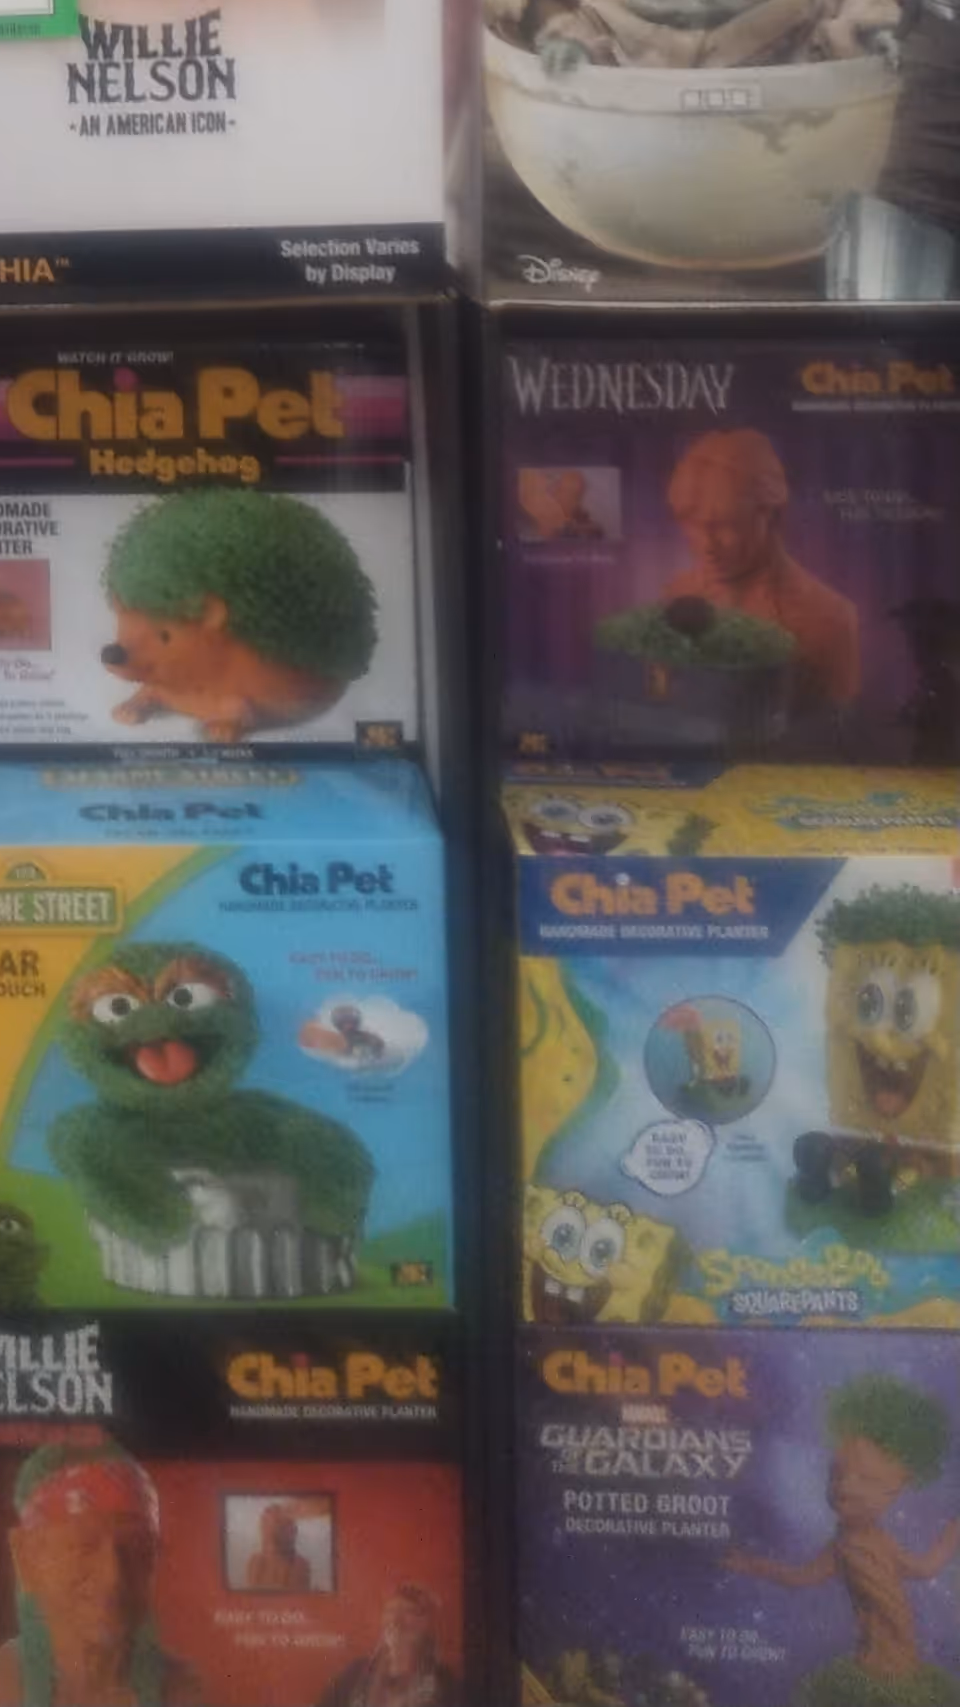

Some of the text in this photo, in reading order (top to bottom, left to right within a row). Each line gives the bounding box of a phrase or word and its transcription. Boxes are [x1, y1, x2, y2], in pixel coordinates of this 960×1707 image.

[77, 5, 222, 61] WILLIE
[66, 58, 238, 104] NELSON
[79, 114, 101, 137] AN
[106, 112, 188, 136] AMERICAN
[280, 238, 421, 259] Selection Varies
[305, 263, 397, 286] by Display
[517, 254, 603, 291] Disney
[508, 355, 736, 416] WEDNESDAY
[800, 360, 955, 396] Chia Pet
[7, 365, 345, 442] Chia Pet
[89, 447, 262, 483] Hedgehog
[79, 802, 265, 822] Chia Pet
[239, 862, 394, 896] Chia Pet
[550, 872, 755, 916] Chia Pet
[31, 891, 113, 922] STREET
[732, 1289, 859, 1315] SQUAREPANTS
[226, 1351, 438, 1400] Chia Pet
[542, 1349, 749, 1399] Chia Pet
[540, 1424, 753, 1455] GUARDIANS
[584, 1450, 748, 1479] GALAXY
[563, 1490, 730, 1517] POTTED GROOT
[565, 1517, 730, 1539] DECORATIVE PLANTER
